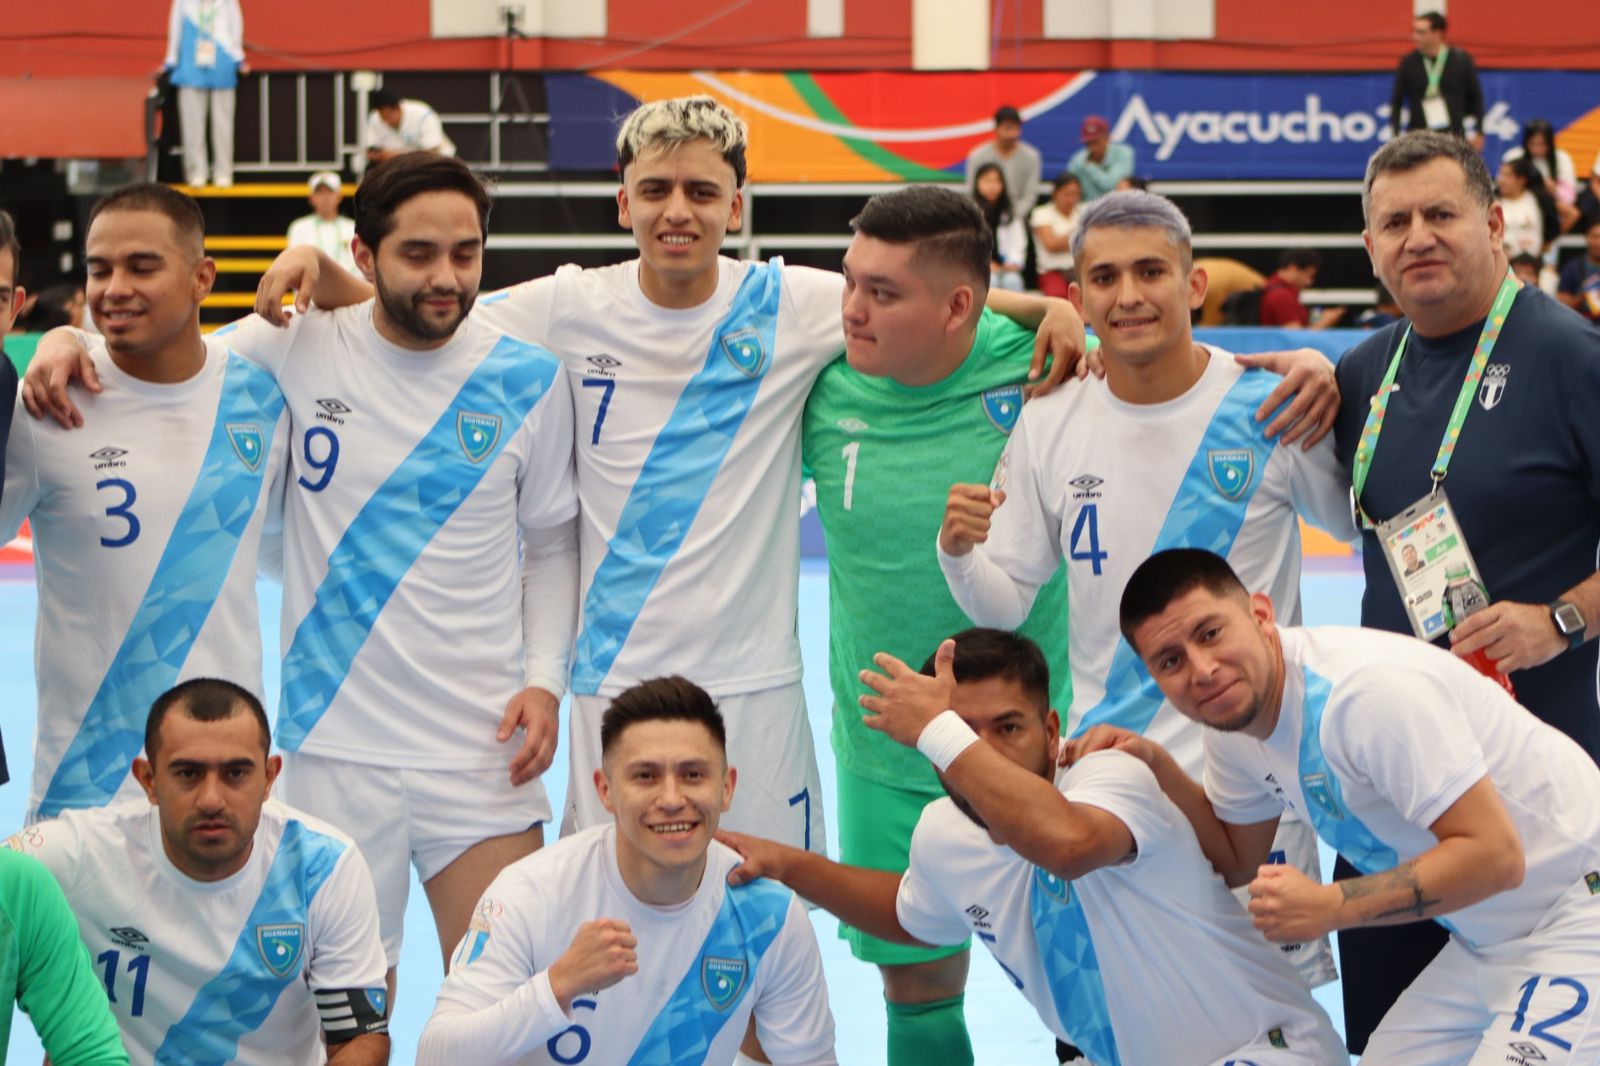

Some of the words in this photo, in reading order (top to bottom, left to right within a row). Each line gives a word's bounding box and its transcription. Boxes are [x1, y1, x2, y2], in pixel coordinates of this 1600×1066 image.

[315, 411, 345, 425] umbro
[582, 379, 615, 445] 7
[94, 459, 127, 471] umbro
[298, 426, 340, 493] 9
[841, 442, 861, 511] 1
[96, 478, 141, 548] 3
[1072, 488, 1103, 499] umbro
[1070, 504, 1108, 576] 4
[111, 937, 145, 951] umbro
[97, 949, 151, 1017] 11
[1510, 975, 1590, 1053] 12
[546, 998, 598, 1066] 6
